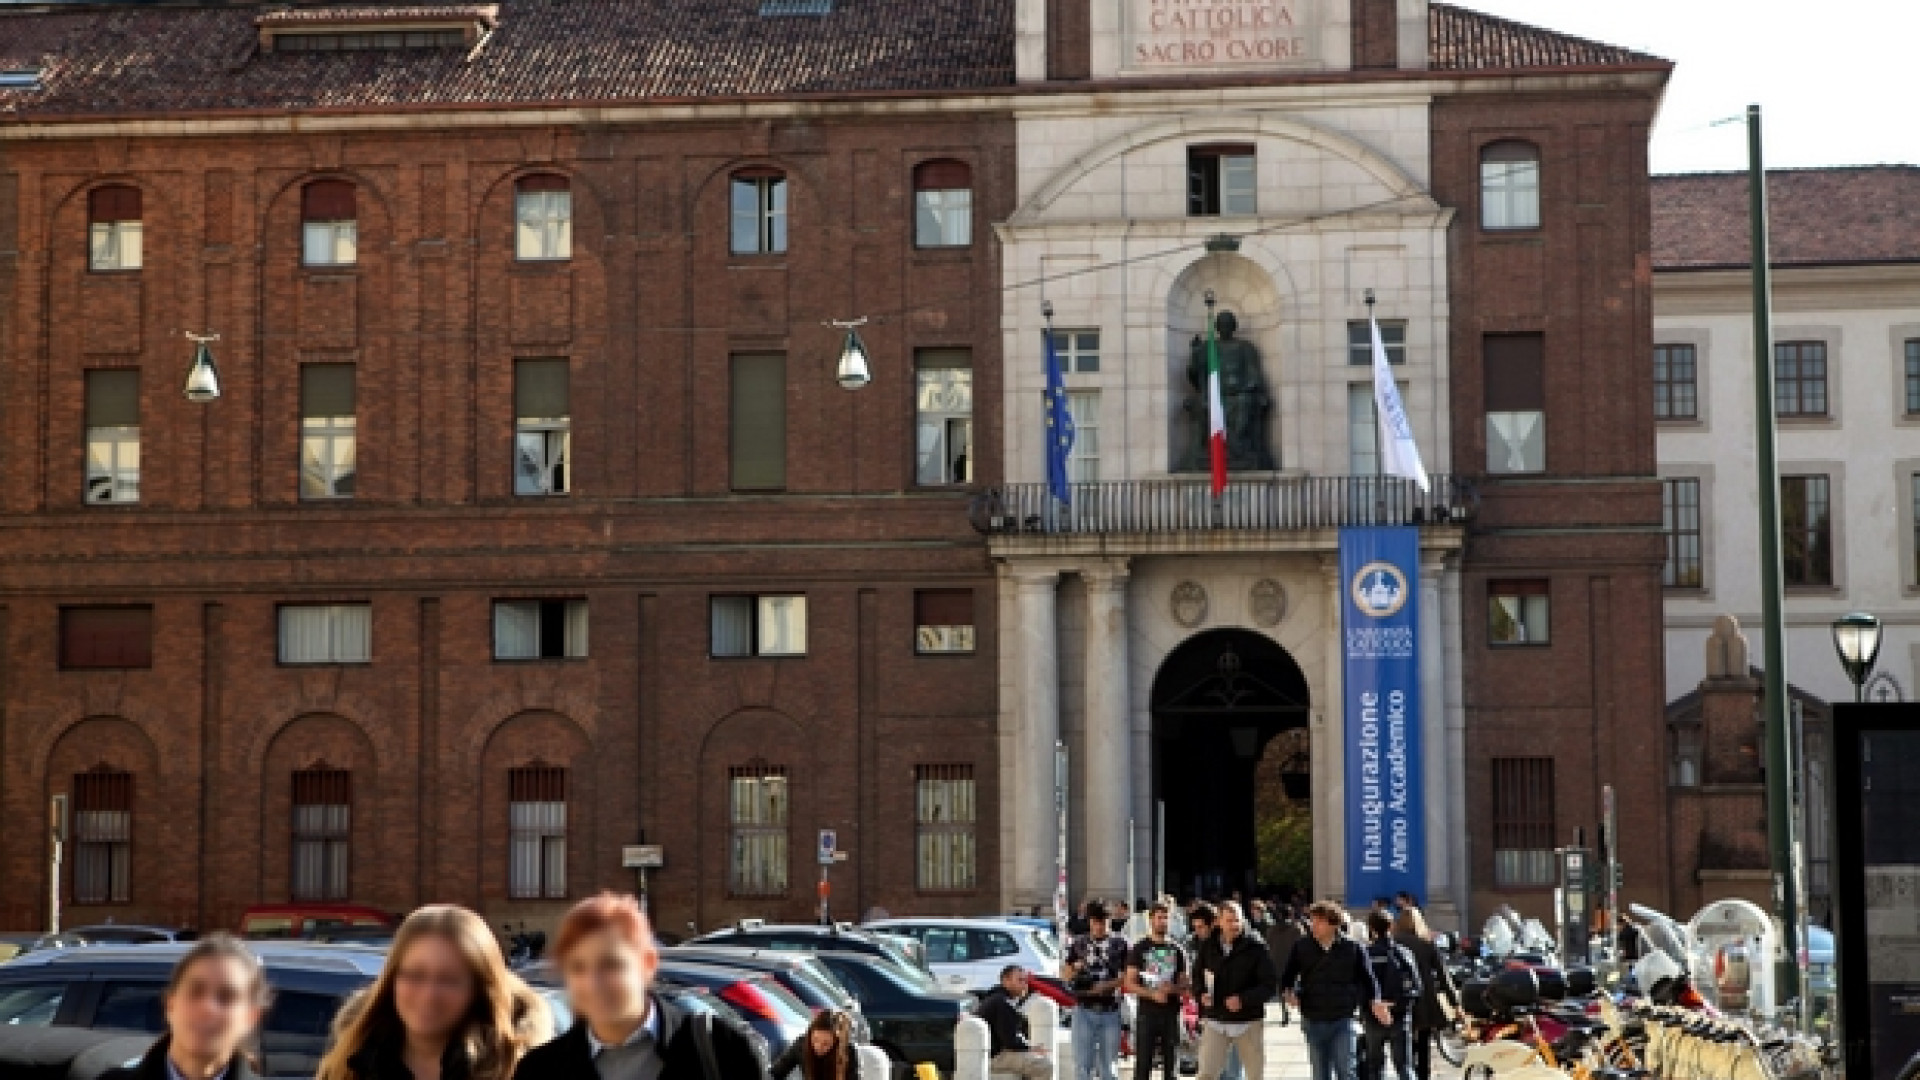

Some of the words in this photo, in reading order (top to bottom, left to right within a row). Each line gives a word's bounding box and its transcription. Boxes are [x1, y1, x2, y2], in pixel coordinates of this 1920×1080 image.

[1151, 6, 1293, 31] CATTOLICA
[1136, 40, 1215, 62] SACRO
[1386, 689, 1407, 814] Accademico
[1360, 691, 1384, 871] Inaugurazione
[1390, 817, 1408, 873] Anno
